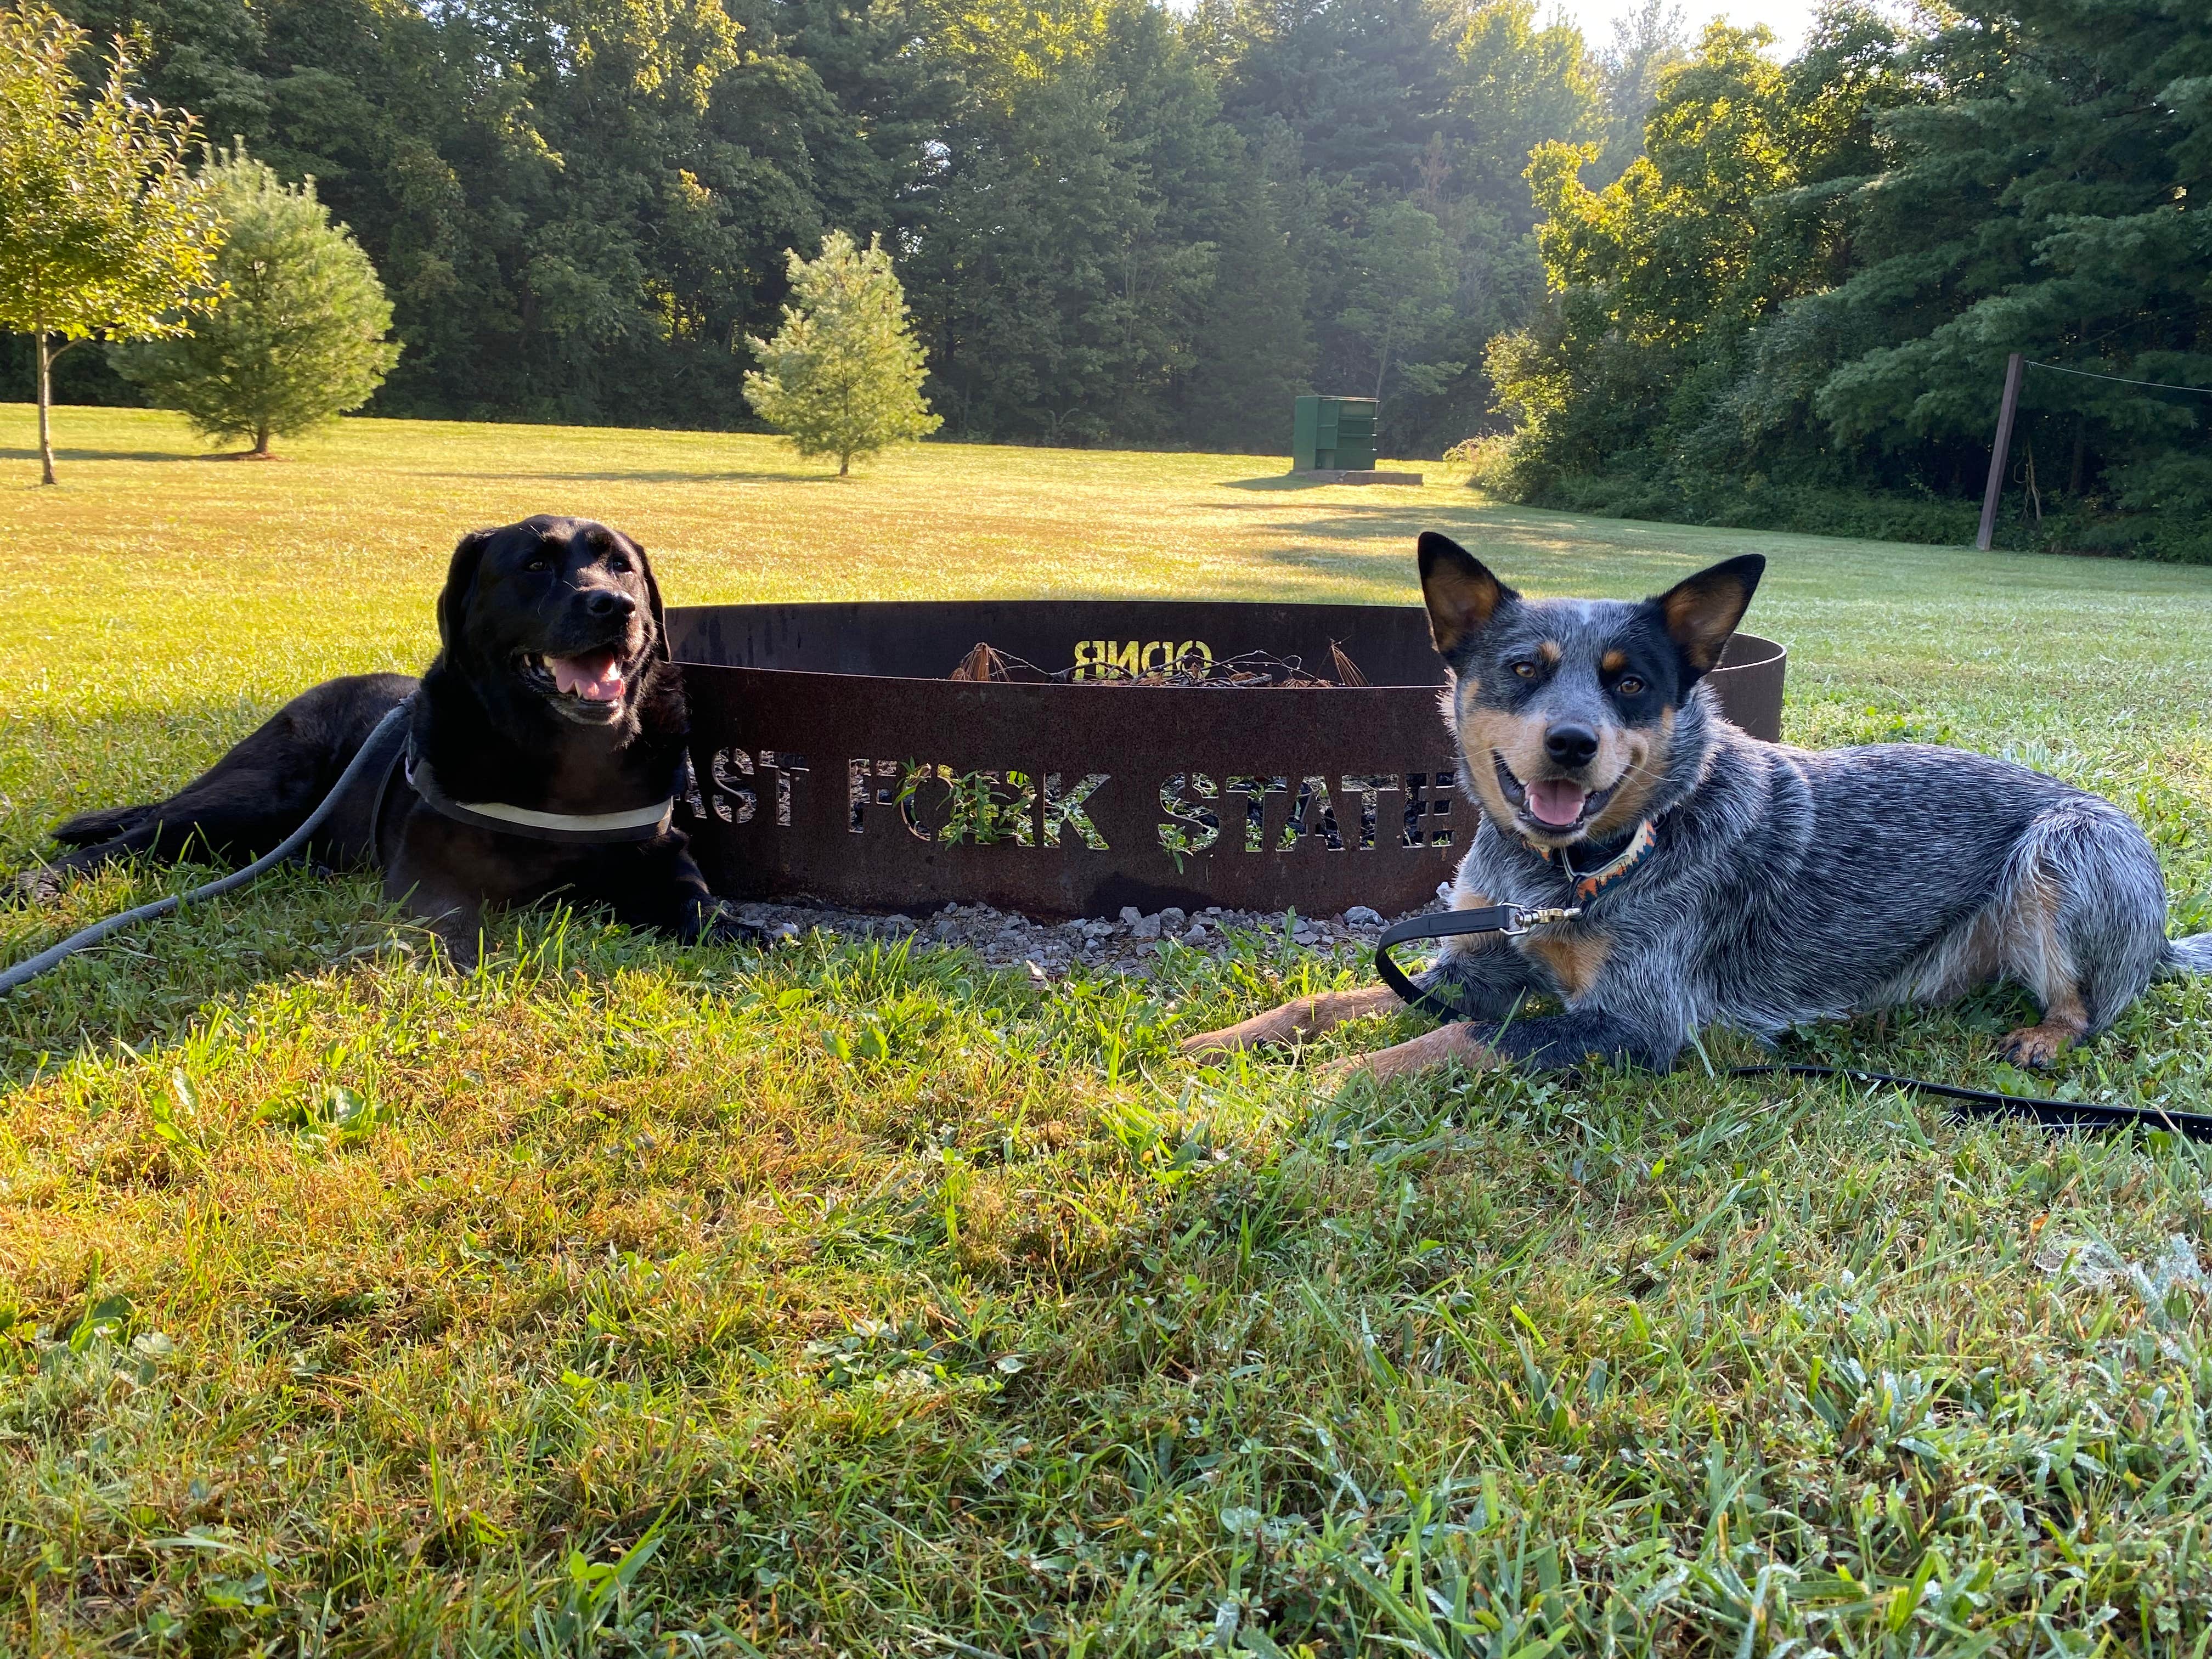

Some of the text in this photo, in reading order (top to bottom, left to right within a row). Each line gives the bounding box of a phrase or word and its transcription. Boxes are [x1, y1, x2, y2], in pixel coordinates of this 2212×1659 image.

[674, 746, 1457, 852] AST FORK STATE
